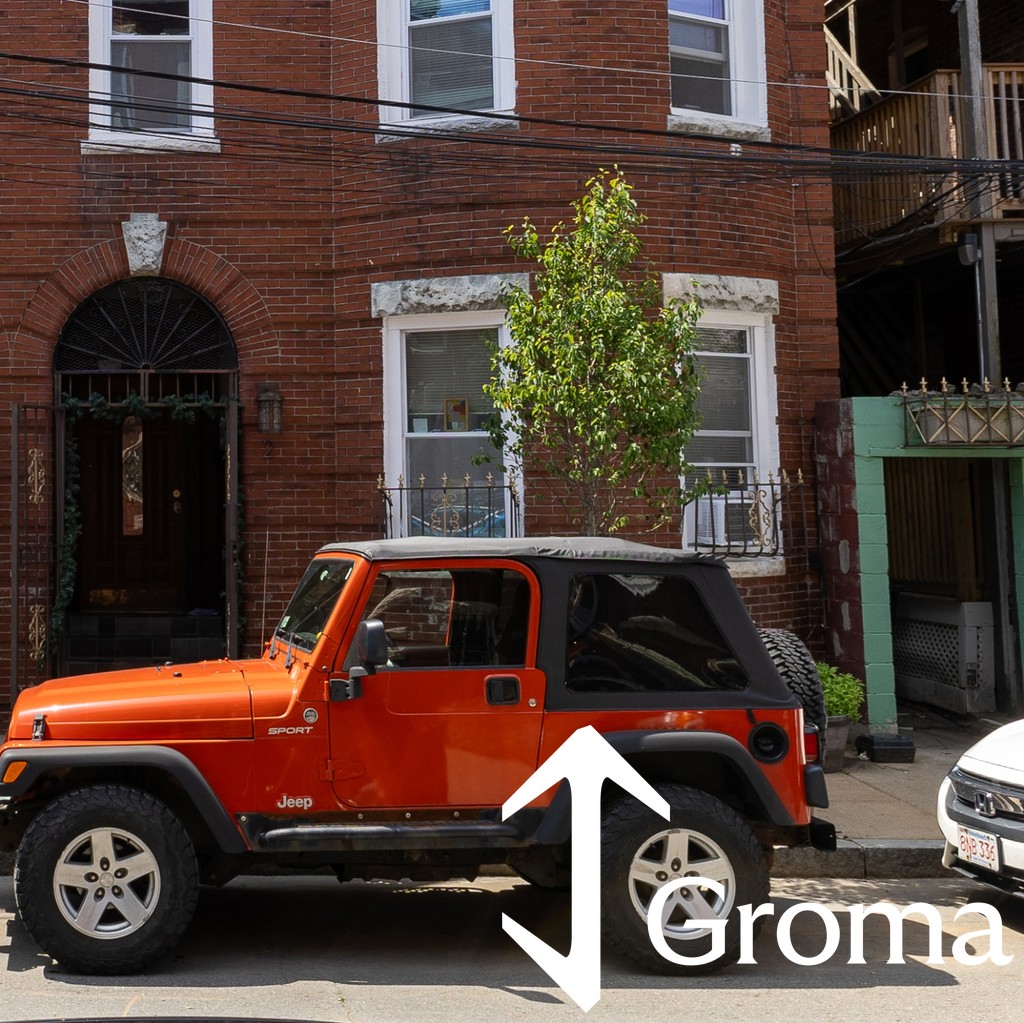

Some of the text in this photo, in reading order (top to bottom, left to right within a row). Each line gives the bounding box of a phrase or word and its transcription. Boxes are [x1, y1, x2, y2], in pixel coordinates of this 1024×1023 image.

[262, 438, 273, 459] 2
[268, 726, 313, 735] SPORT
[277, 794, 313, 810] Jeep
[978, 840, 995, 861] 336
